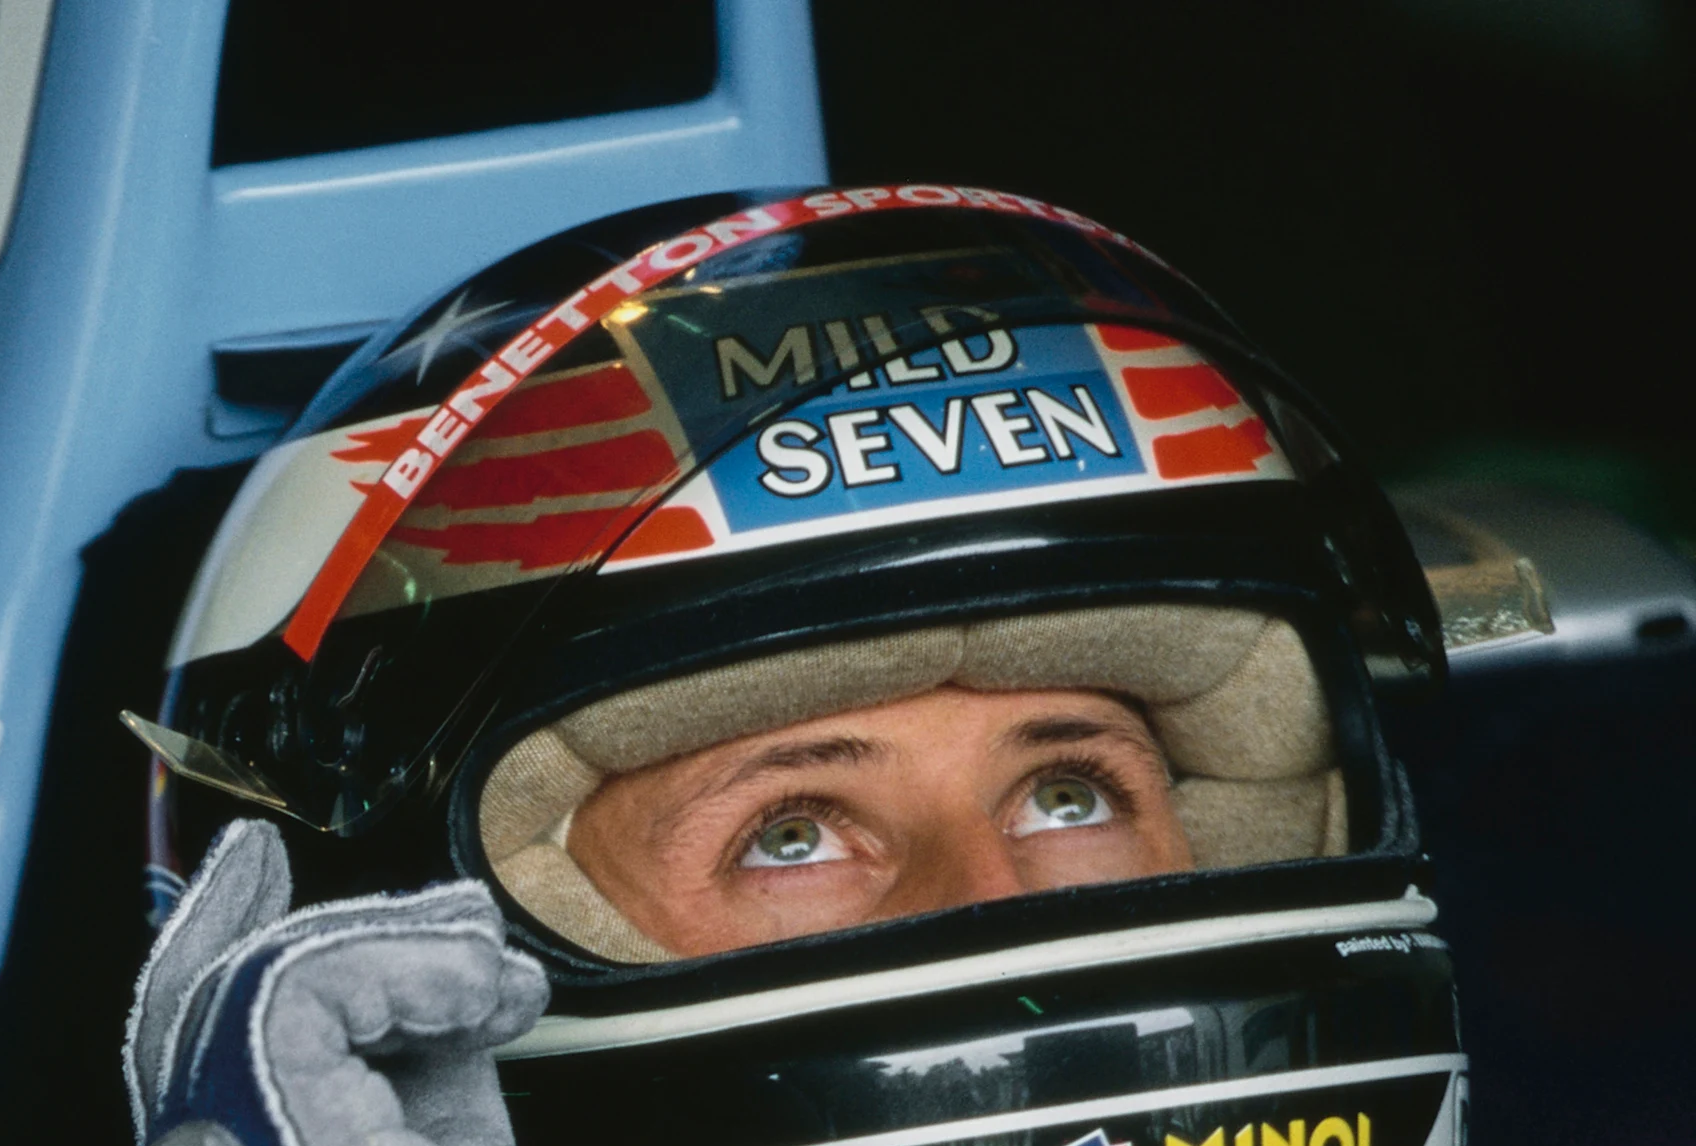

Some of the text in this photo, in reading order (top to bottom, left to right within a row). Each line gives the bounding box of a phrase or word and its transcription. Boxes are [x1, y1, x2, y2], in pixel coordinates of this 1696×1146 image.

[382, 208, 782, 500] BENETTON
[713, 303, 1018, 399] MILD
[757, 384, 1122, 497] SEVEN
